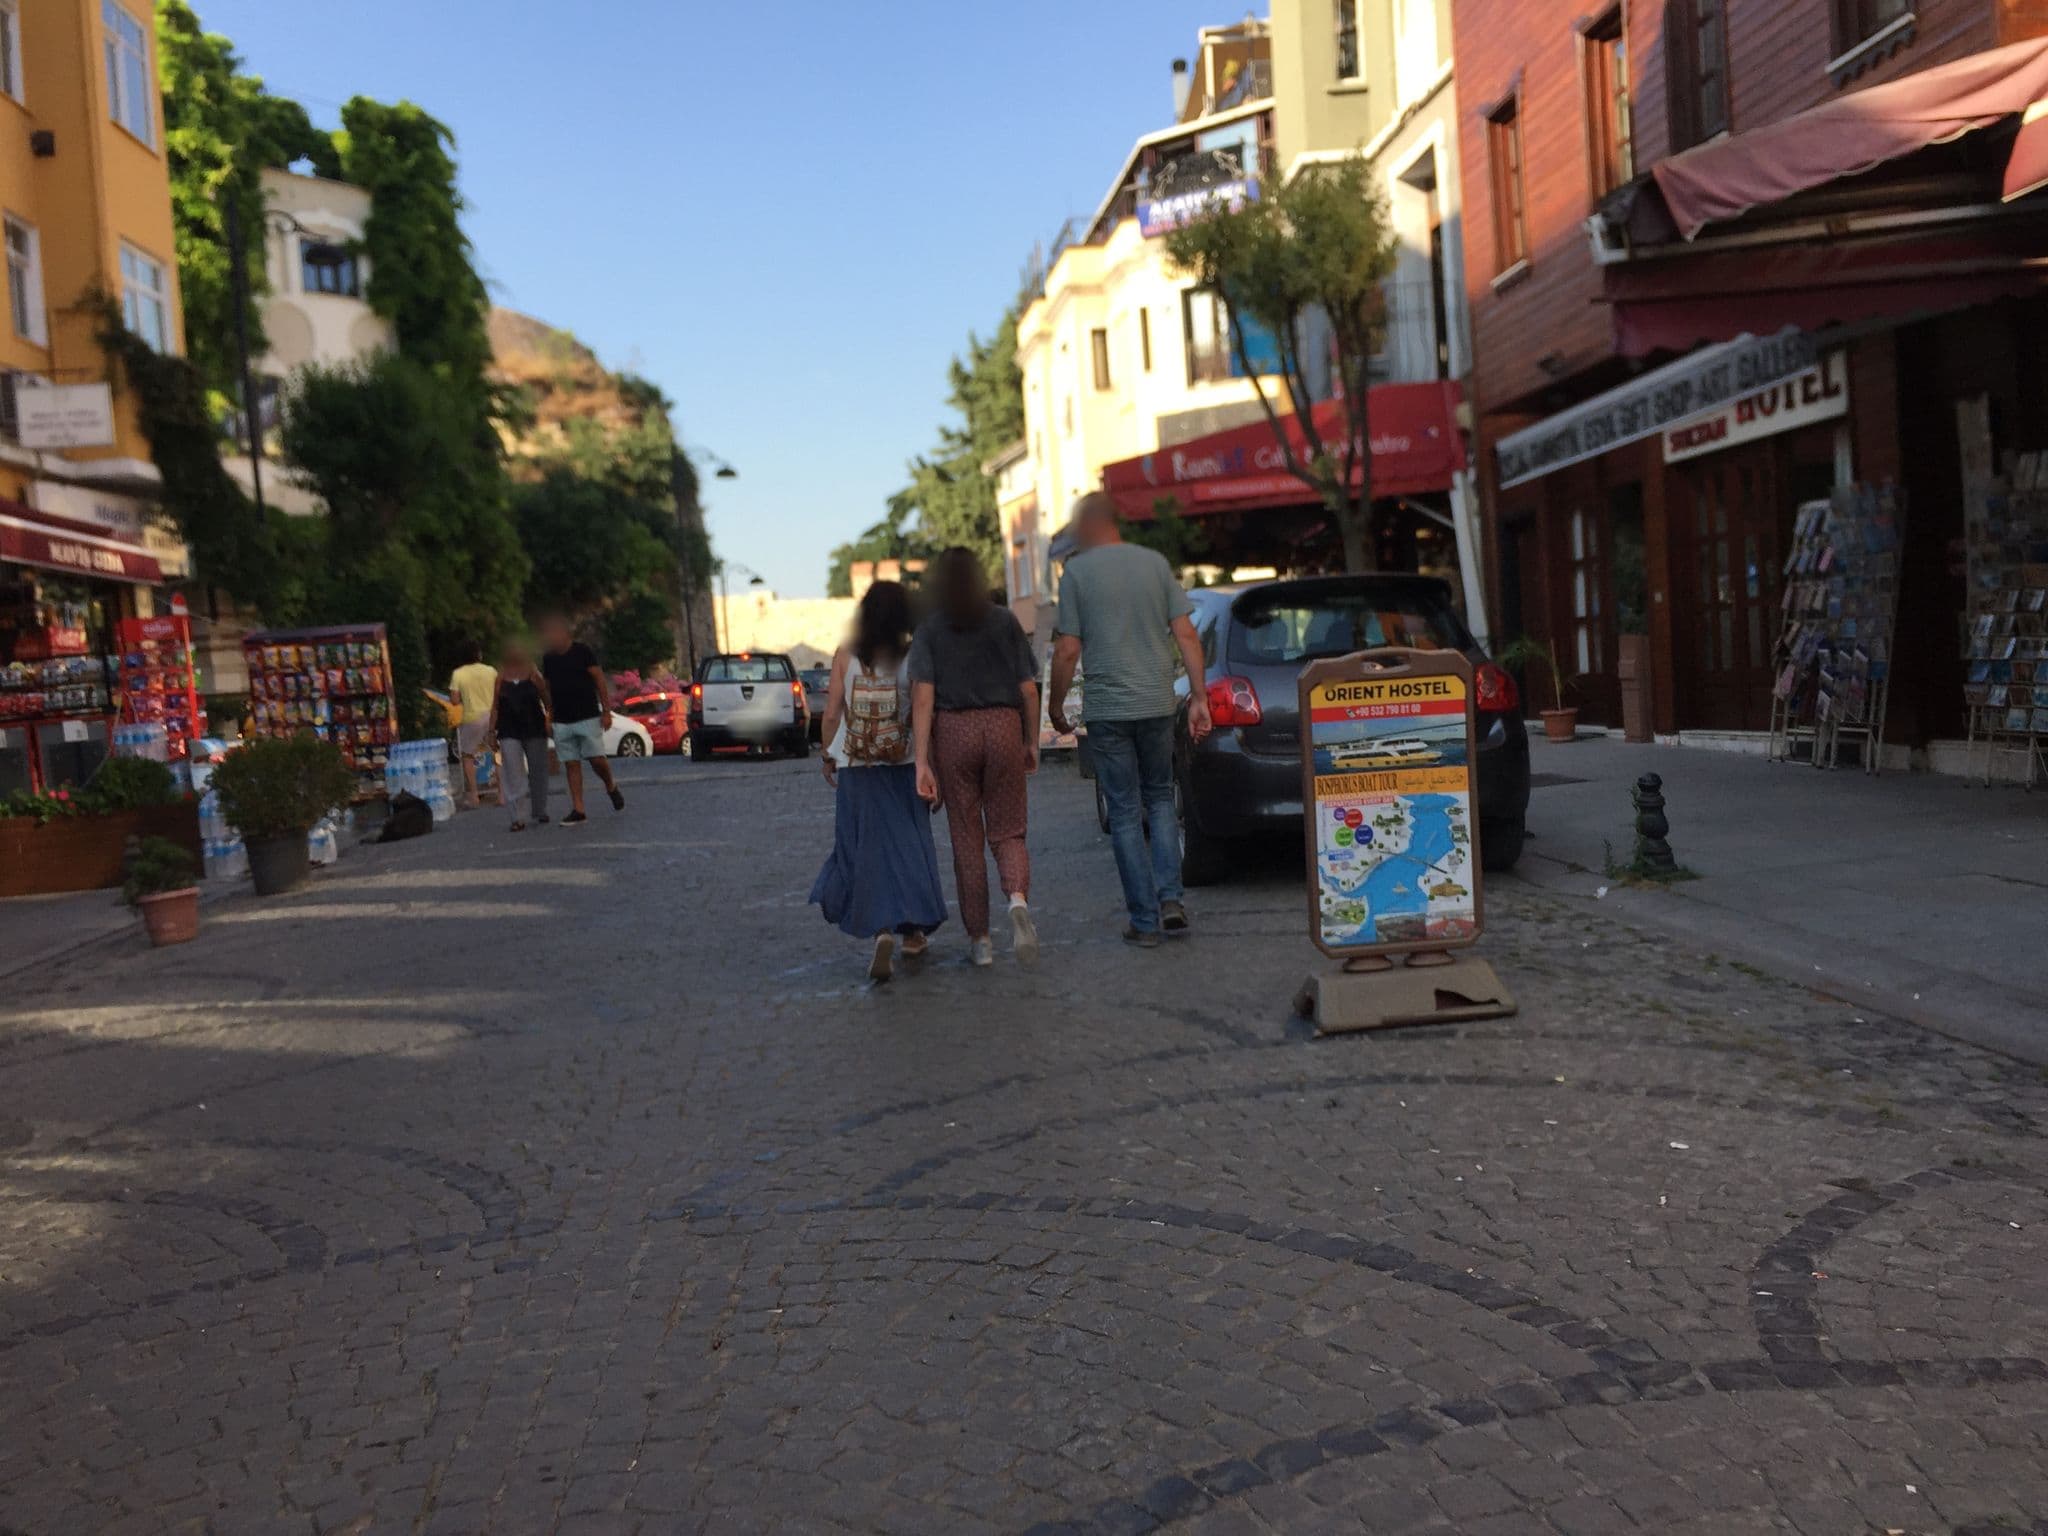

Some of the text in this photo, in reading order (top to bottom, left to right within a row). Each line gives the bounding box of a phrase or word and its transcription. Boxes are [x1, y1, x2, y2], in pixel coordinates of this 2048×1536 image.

[1325, 681, 1451, 702] ORIENT HOSTEL
[1317, 775, 1357, 796] BOSPHORUS
[1358, 773, 1377, 793] BOAT
[1379, 772, 1398, 791] TOUR
